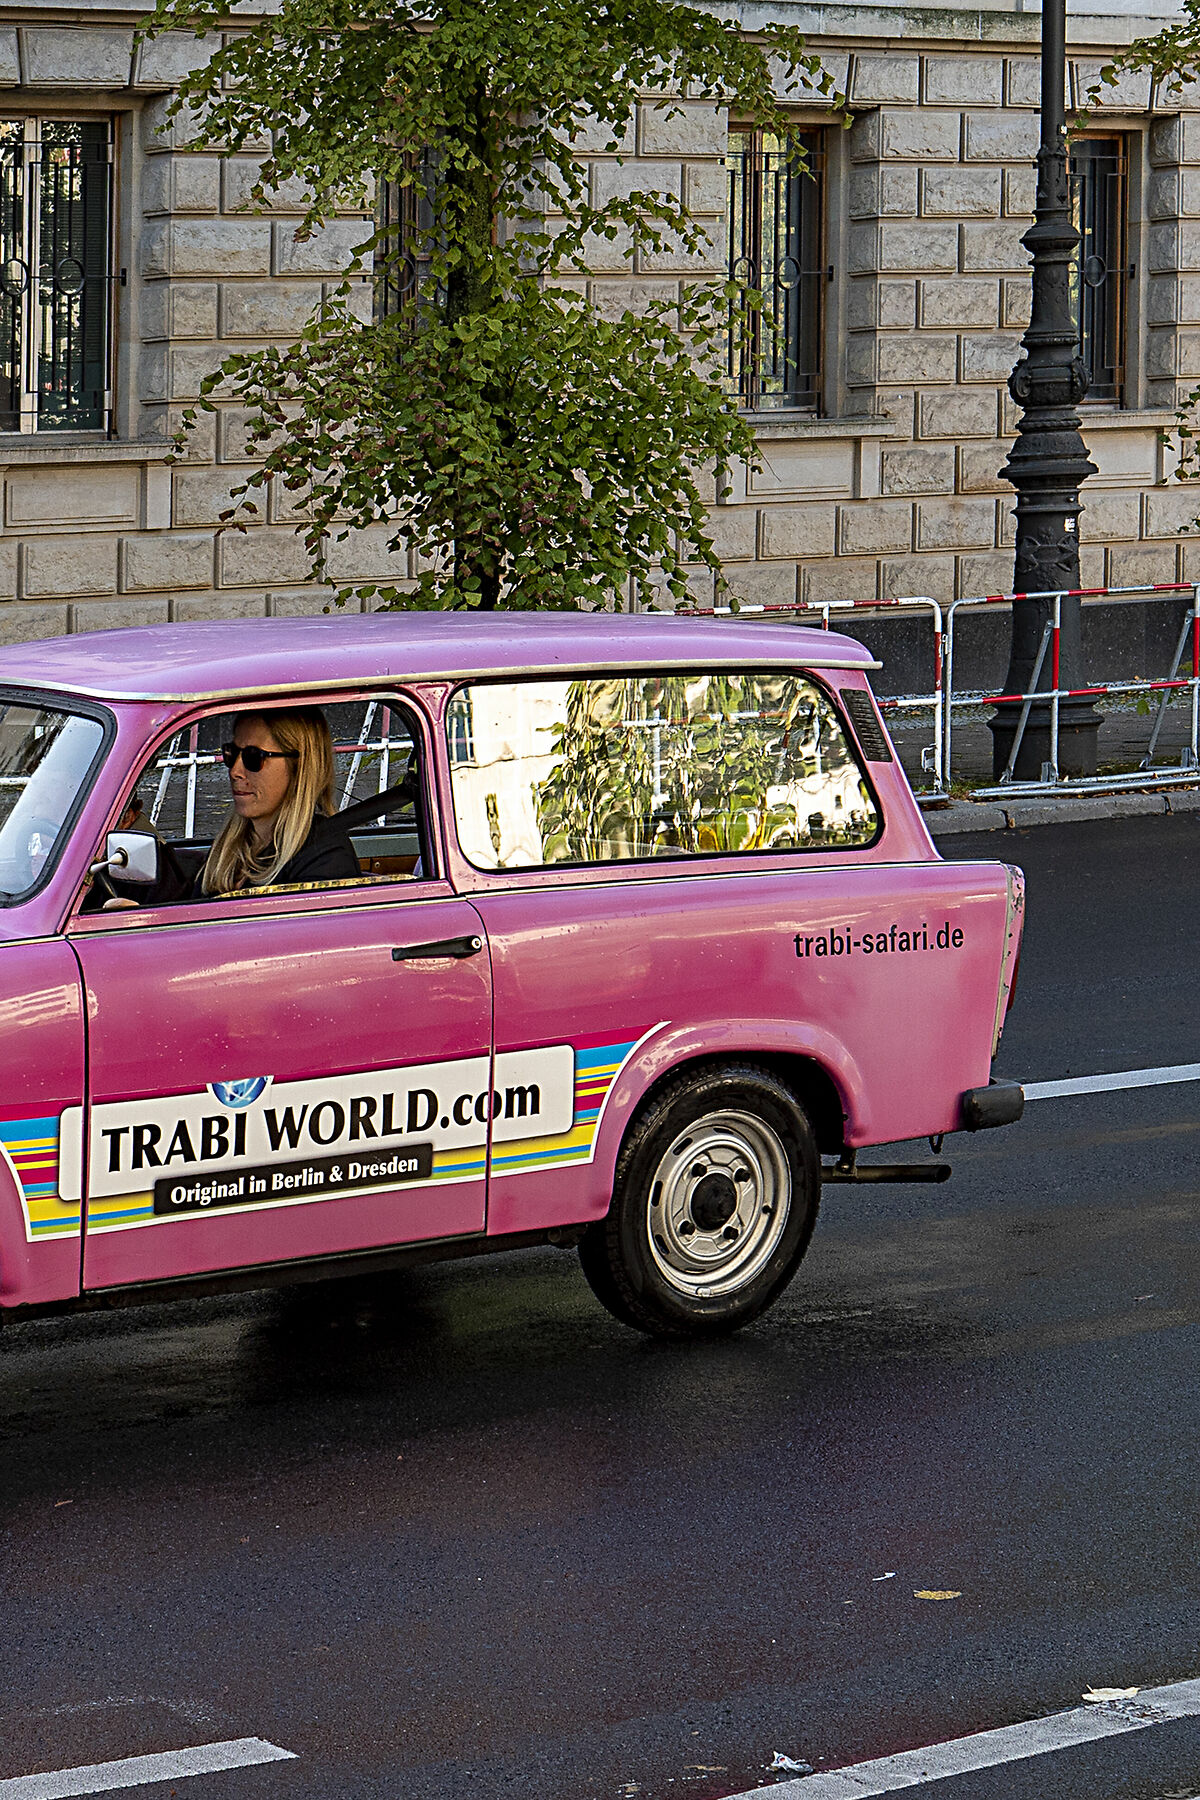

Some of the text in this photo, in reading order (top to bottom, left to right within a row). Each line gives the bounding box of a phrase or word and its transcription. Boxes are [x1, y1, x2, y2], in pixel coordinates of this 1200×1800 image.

[793, 921, 964, 957] trabi-safari.de
[101, 1083, 541, 1173] TRABI WORLD.com
[170, 1155, 419, 1206] Original in Berlin & Dresden
